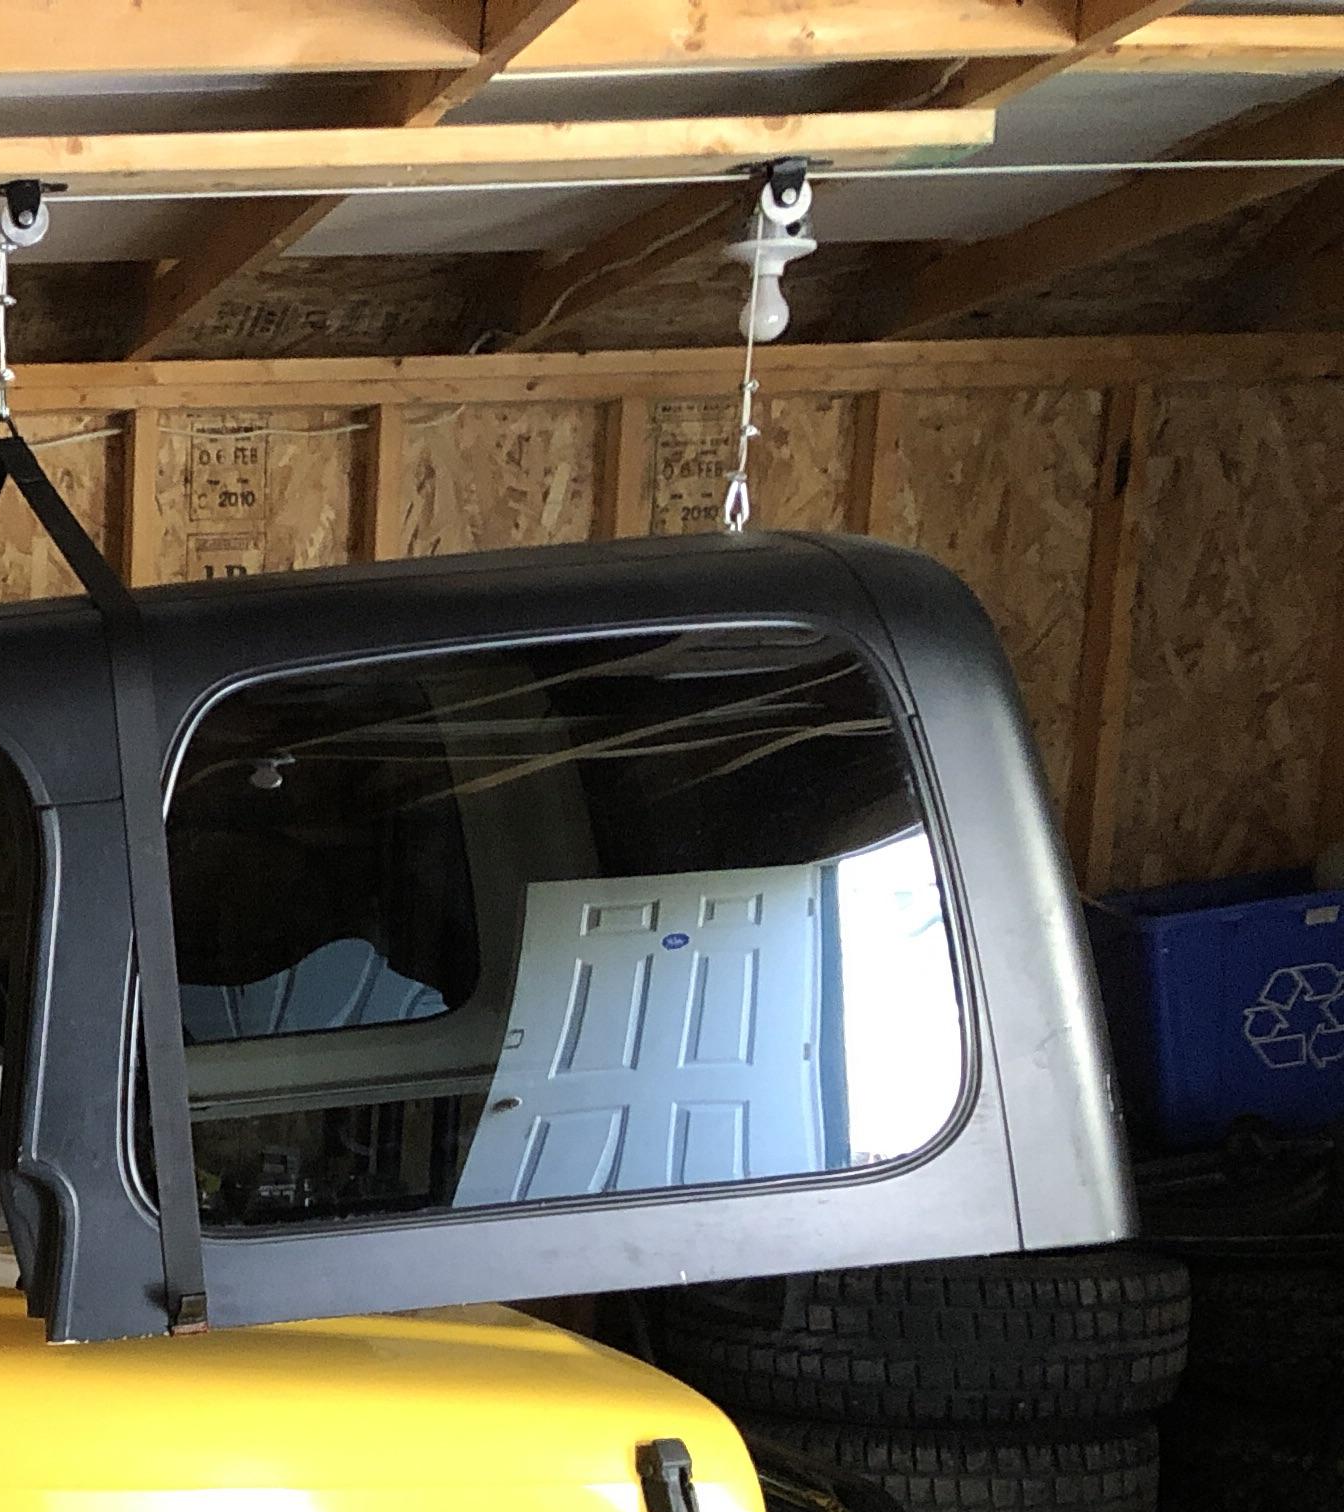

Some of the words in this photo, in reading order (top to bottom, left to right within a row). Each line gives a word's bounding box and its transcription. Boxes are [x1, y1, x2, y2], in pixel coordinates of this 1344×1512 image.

[233, 447, 259, 466] FEB
[698, 461, 723, 477] FEB
[218, 491, 256, 508] 2010
[681, 505, 720, 521] 2010
